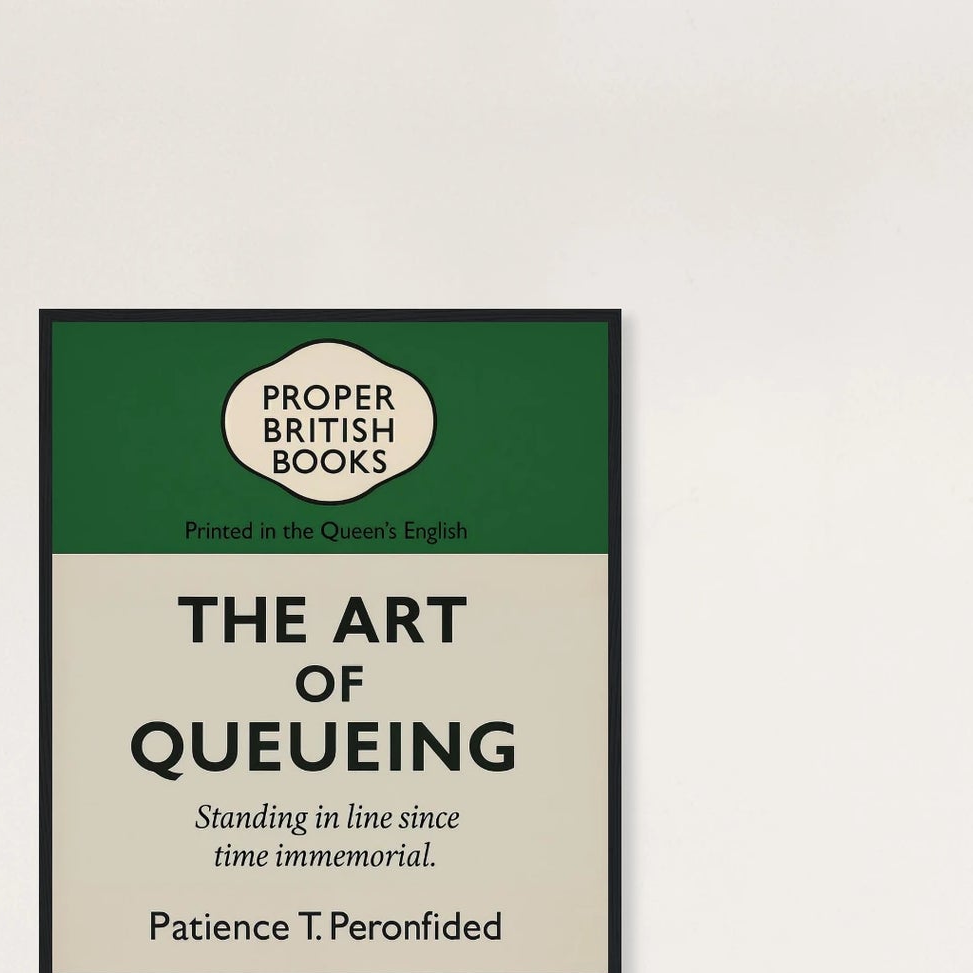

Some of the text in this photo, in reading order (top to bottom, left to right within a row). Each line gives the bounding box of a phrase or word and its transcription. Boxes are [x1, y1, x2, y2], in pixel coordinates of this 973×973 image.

[264, 385, 394, 410] PROPER
[265, 418, 393, 442] BRITISH
[274, 449, 386, 474] BOOKS
[186, 522, 467, 544] Printed in the Queen’s English
[178, 597, 467, 642] THE ART
[296, 665, 363, 702] OF
[131, 721, 514, 781] QUEUEING
[196, 803, 459, 835] Standing in line since
[215, 842, 434, 867] time immemorial.
[151, 911, 501, 940] Patience T. Peronfided
